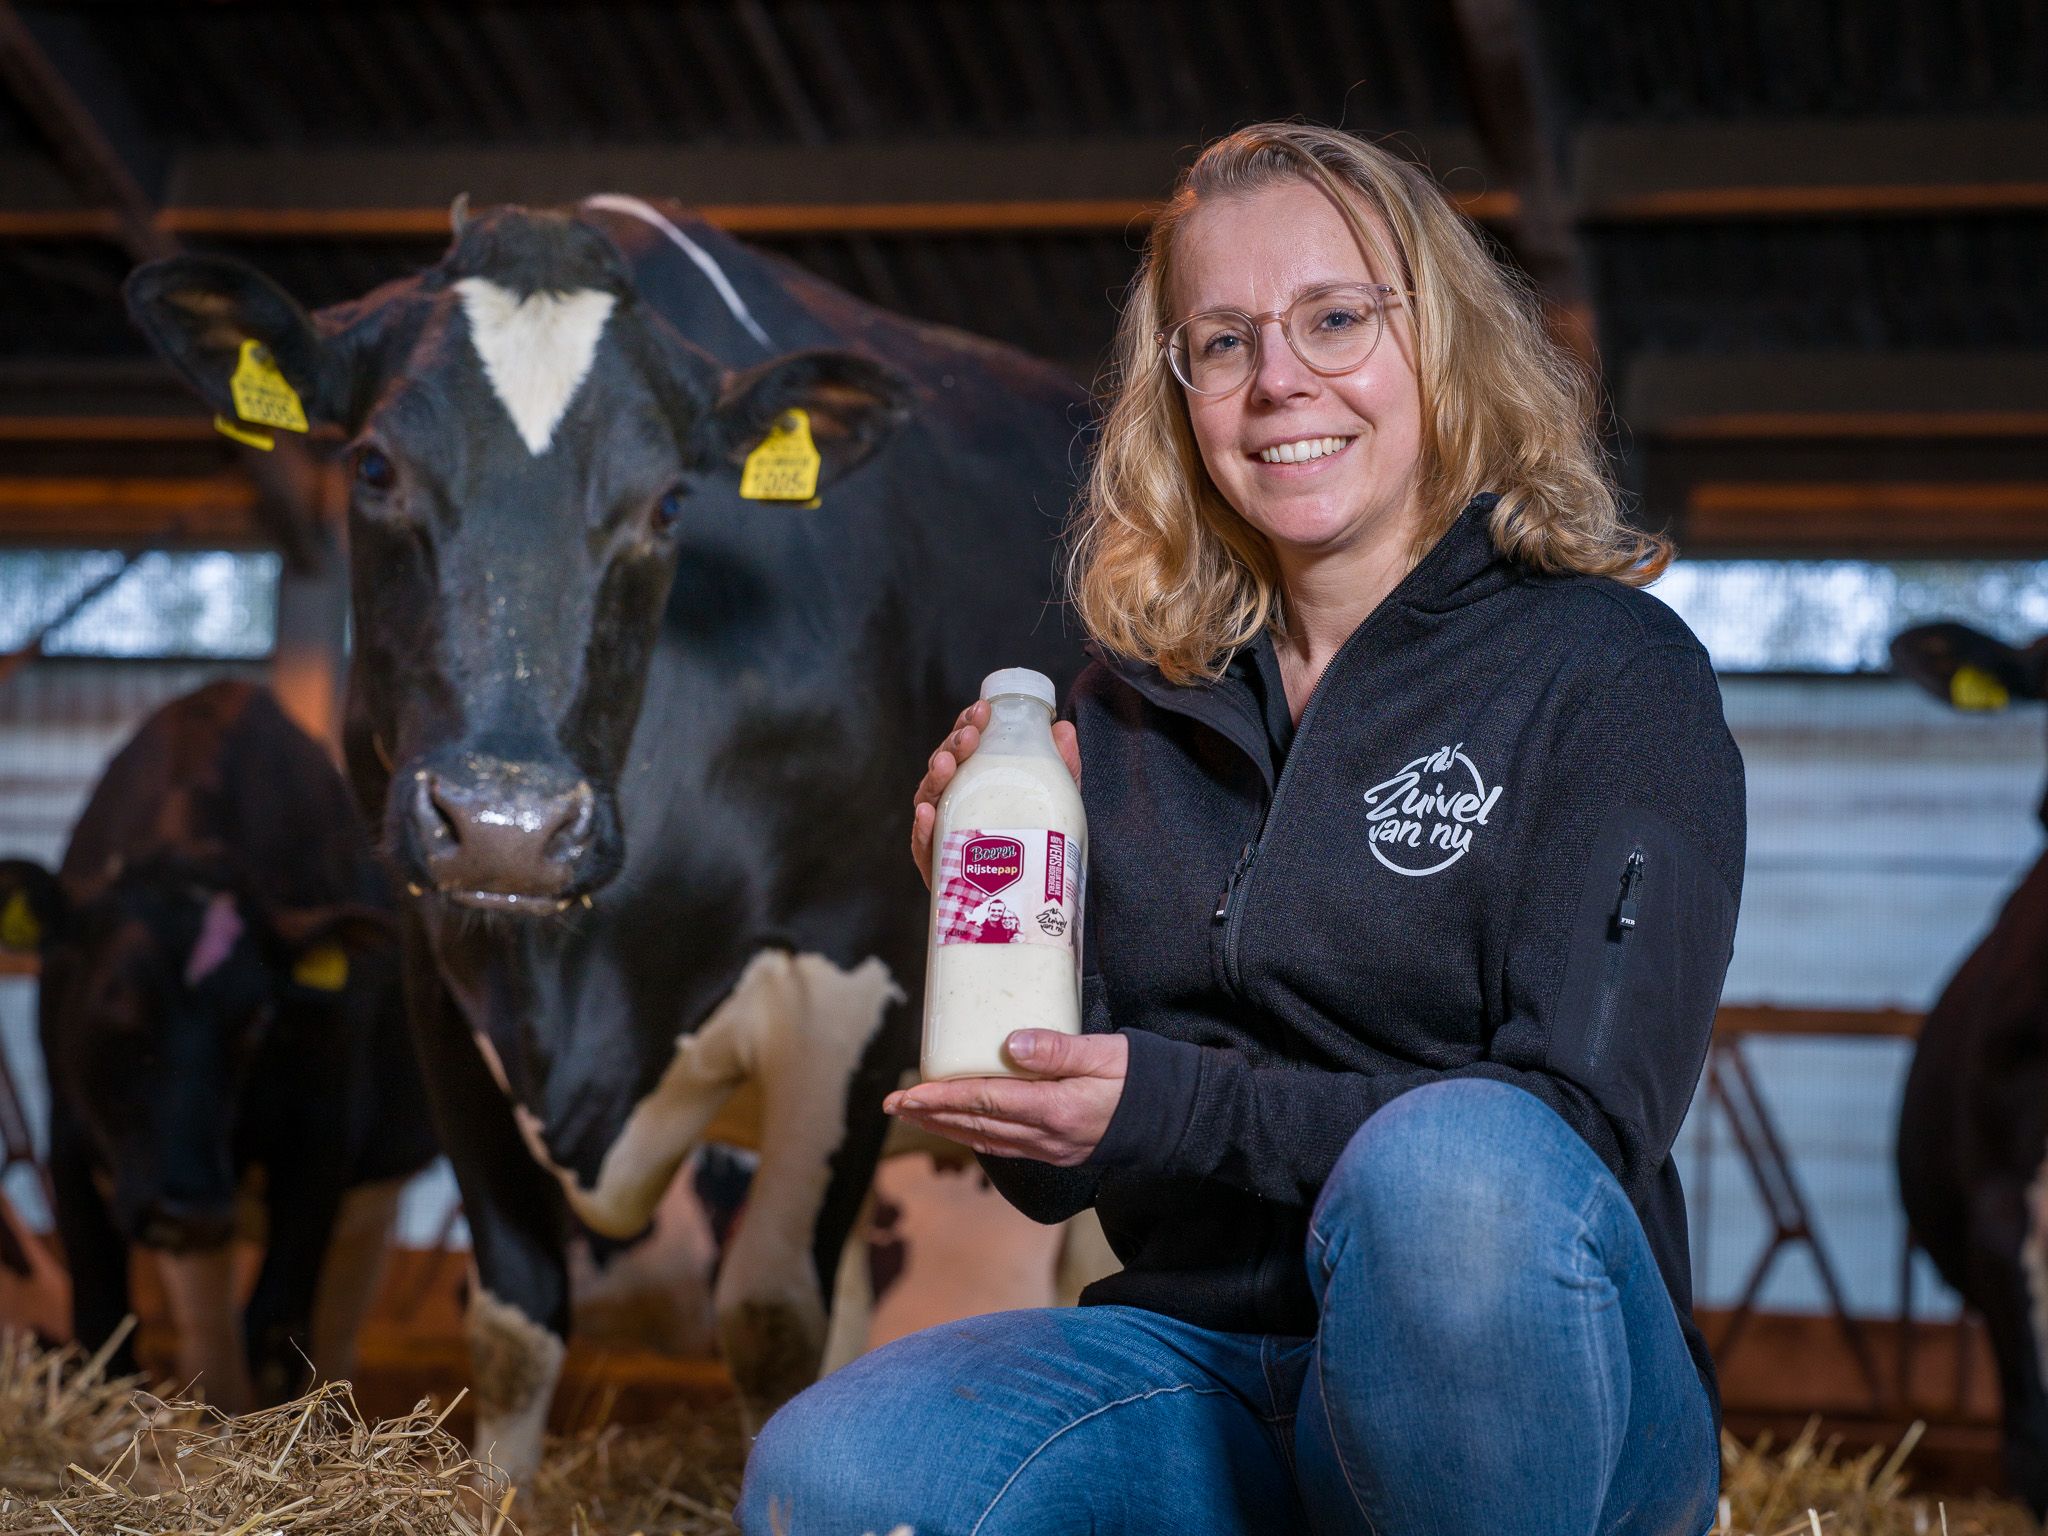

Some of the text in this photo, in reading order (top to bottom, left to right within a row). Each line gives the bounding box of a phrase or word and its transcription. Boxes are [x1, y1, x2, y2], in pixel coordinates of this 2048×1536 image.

[1364, 772, 1503, 825] Zuivel
[1368, 819, 1473, 852] van nu
[969, 845, 1018, 862] Boeren
[1049, 843, 1063, 867] VERS
[966, 864, 1019, 876] Rijstepap
[1047, 865, 1056, 896] BOERDERIJ
[1036, 912, 1067, 928] Zuivel
